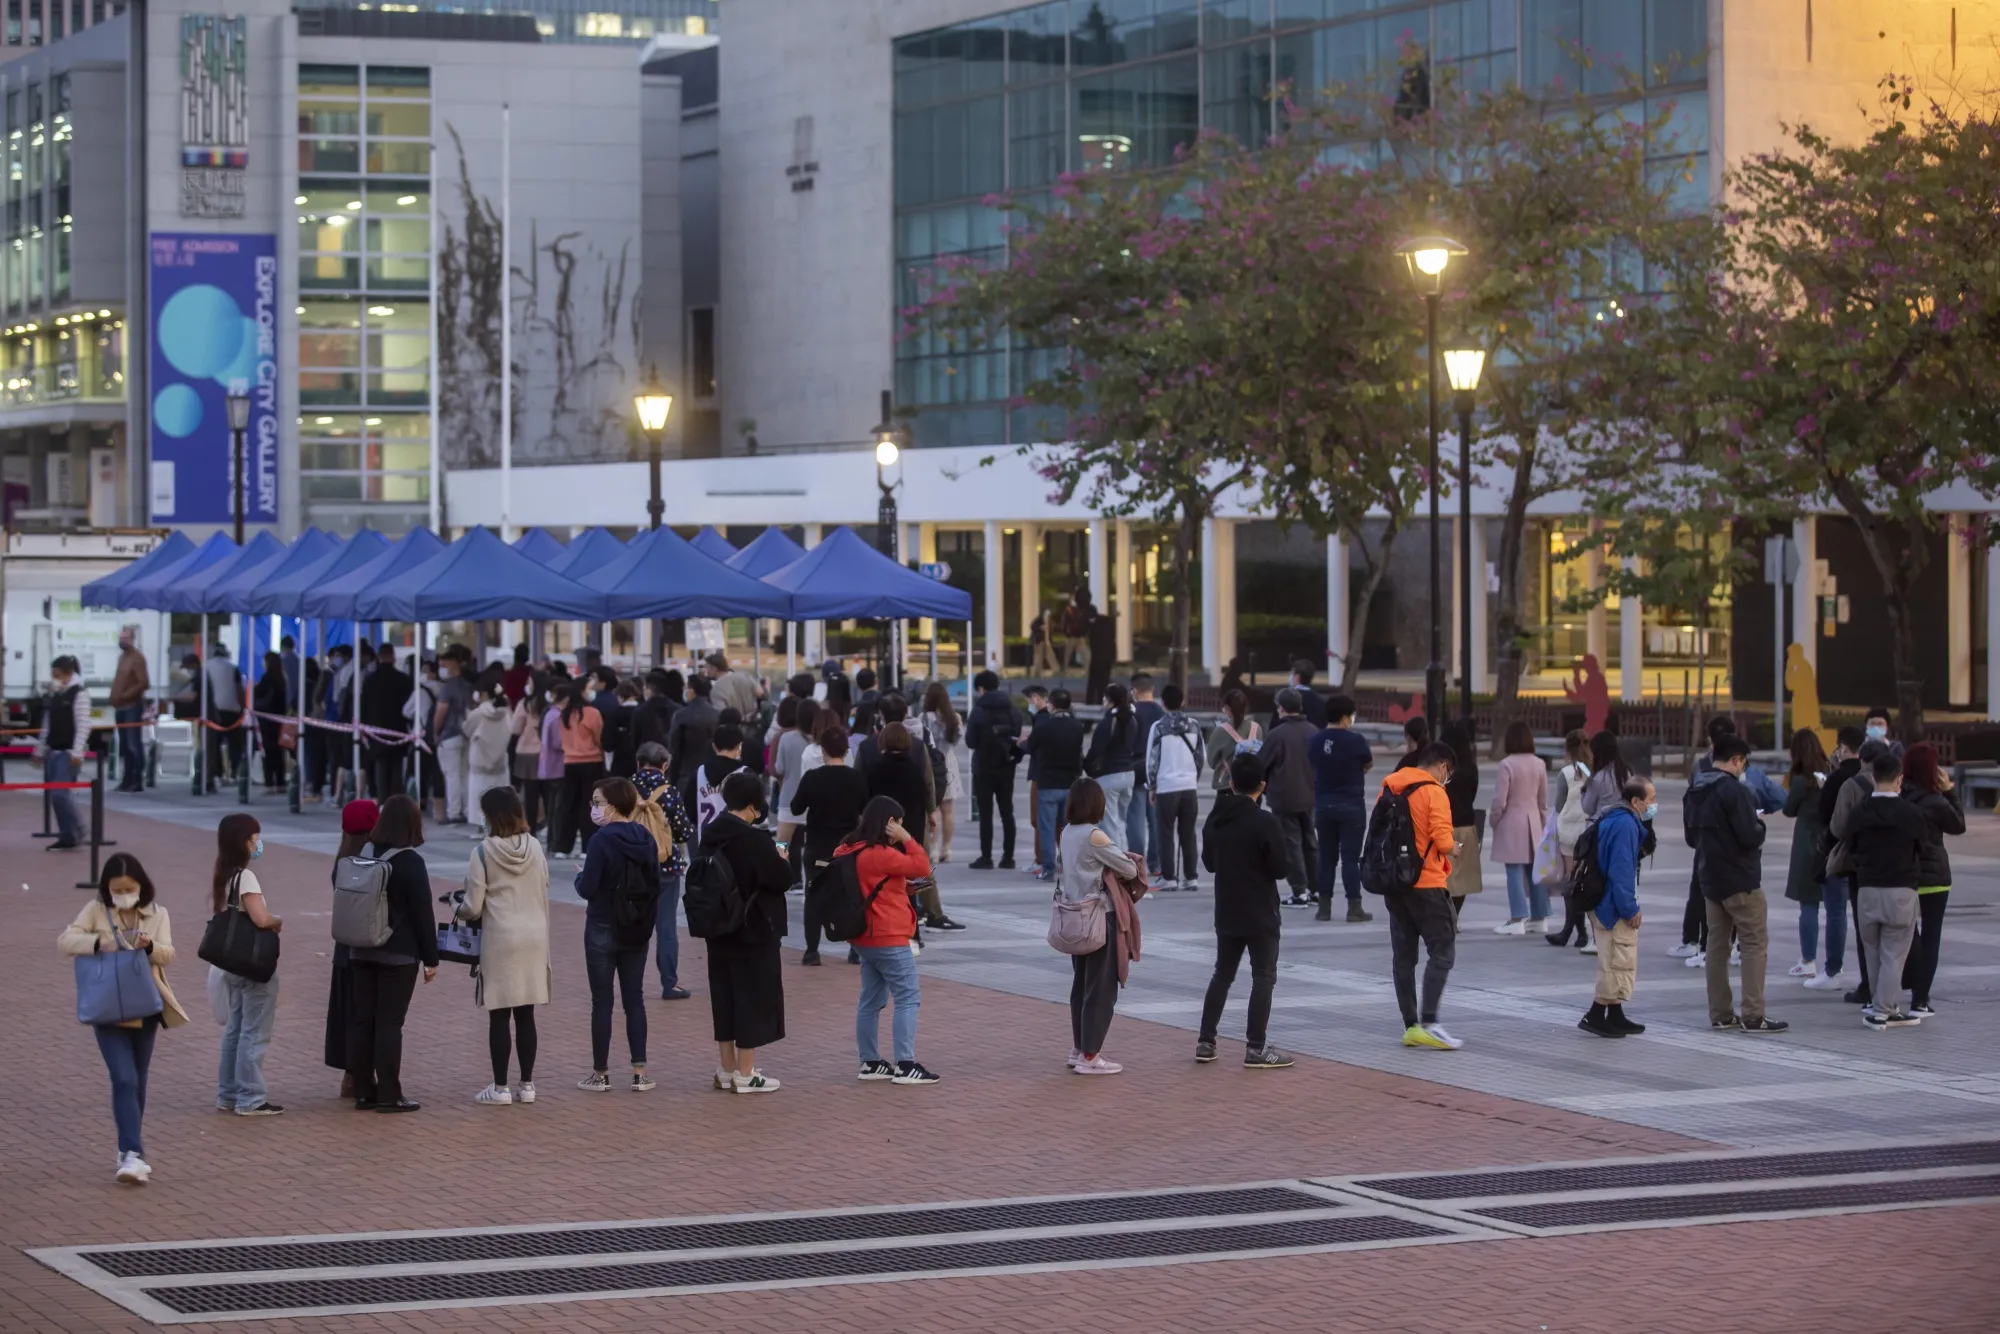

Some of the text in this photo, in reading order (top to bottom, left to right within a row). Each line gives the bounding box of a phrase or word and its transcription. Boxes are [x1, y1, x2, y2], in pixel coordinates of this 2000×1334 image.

[257, 360, 277, 412] CITY
[257, 414, 277, 514] GALLERY
[748, 1076, 766, 1087] N
